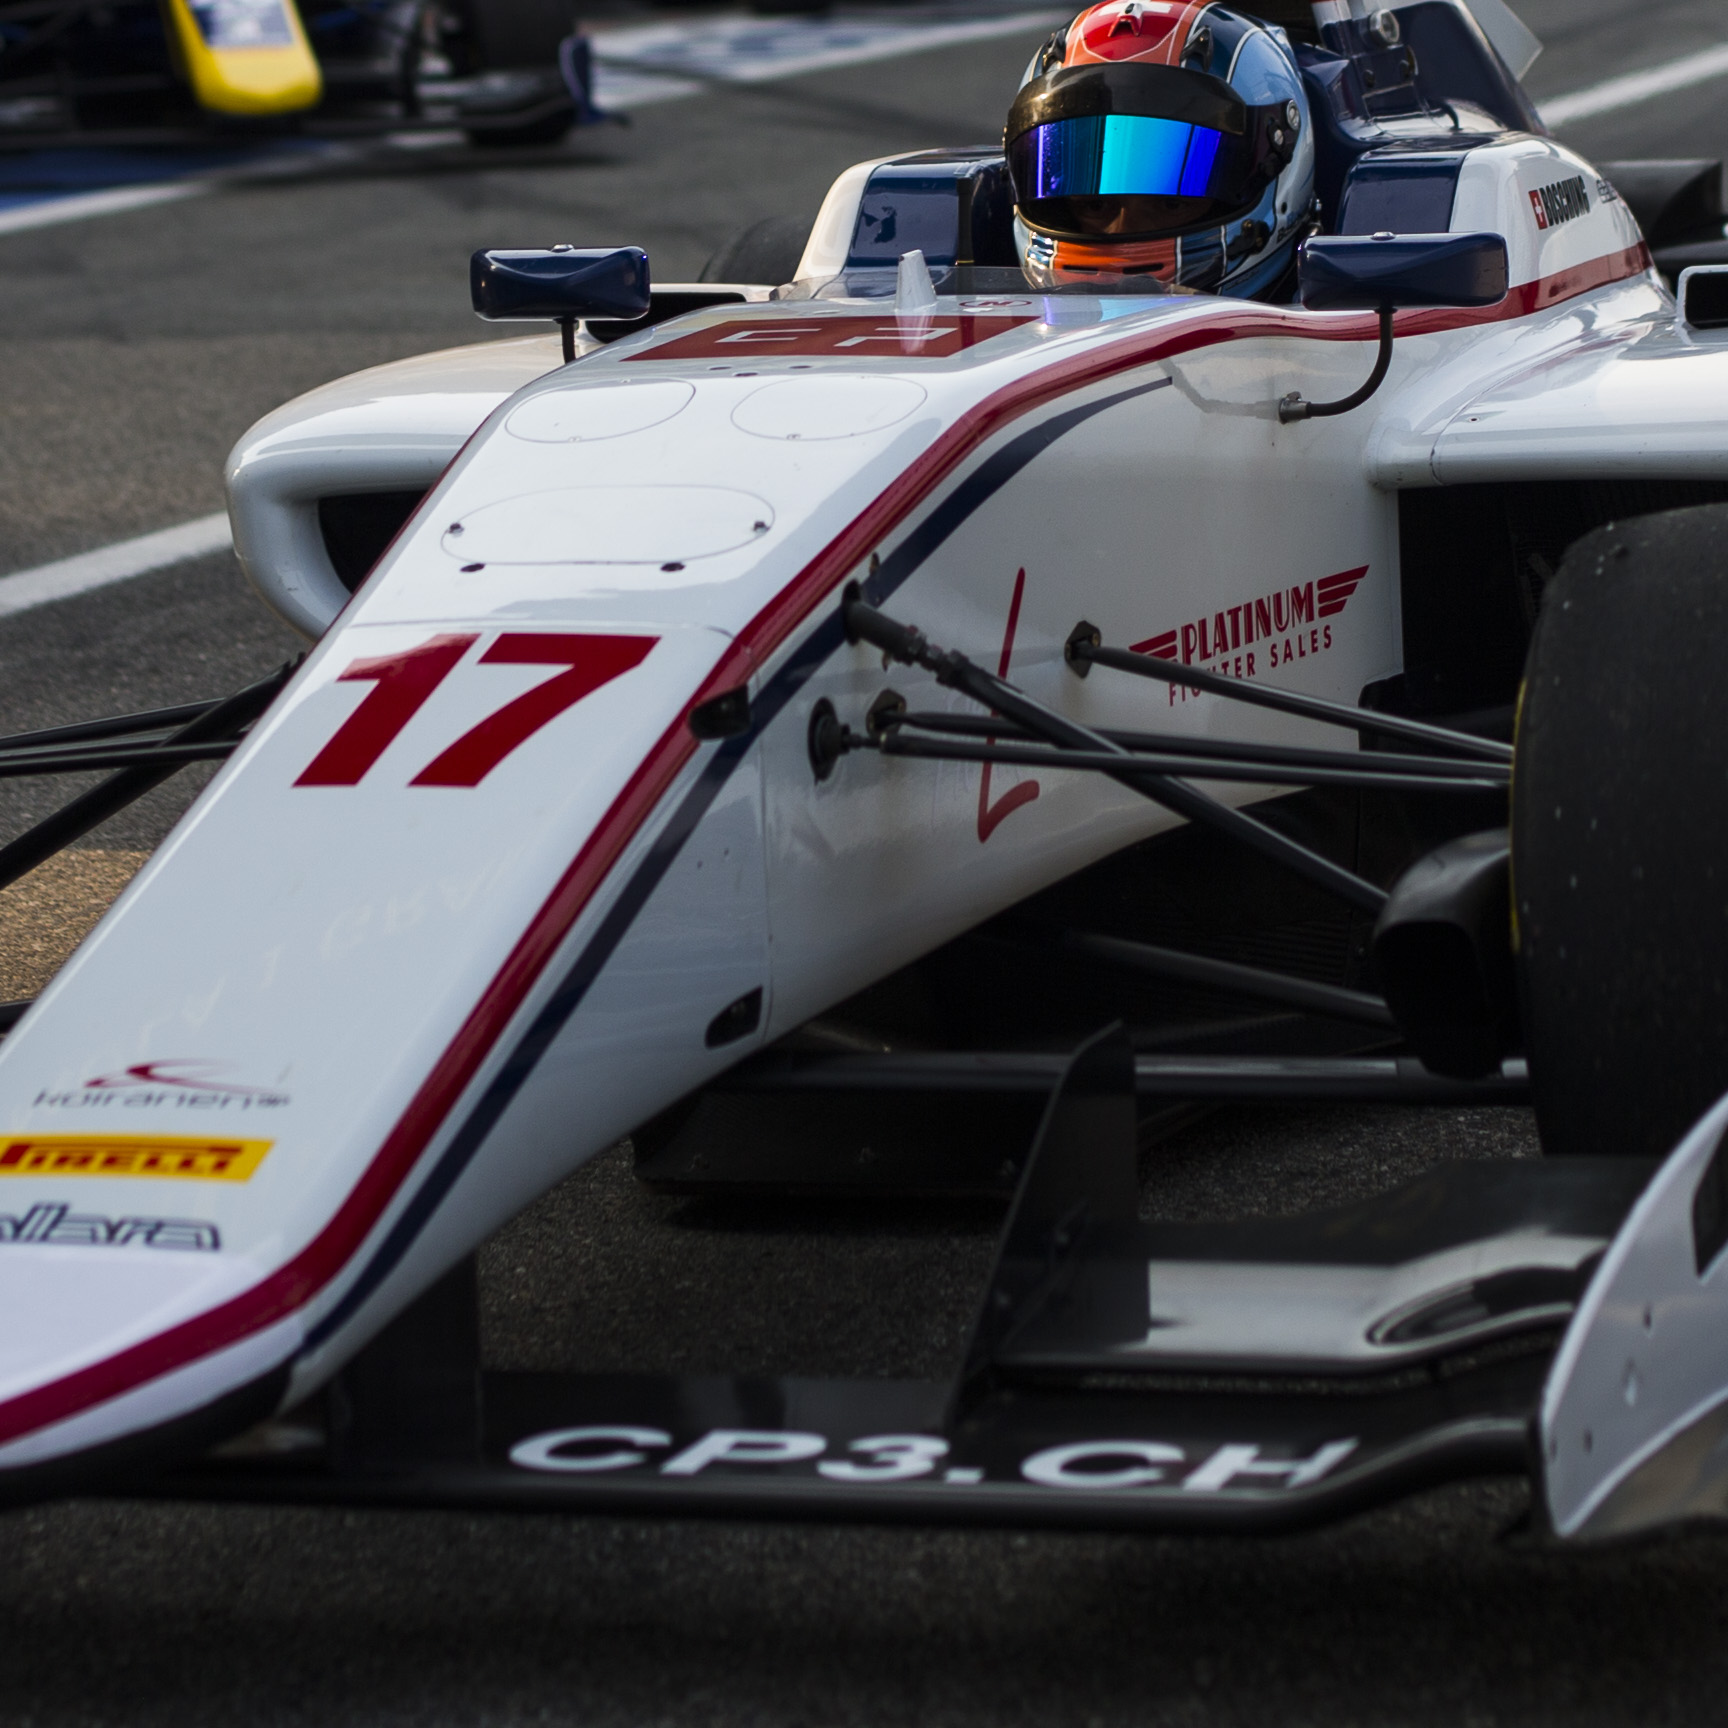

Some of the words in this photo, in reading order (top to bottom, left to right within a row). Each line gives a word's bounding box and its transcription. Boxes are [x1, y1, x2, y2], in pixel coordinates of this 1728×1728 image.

[1180, 580, 1315, 666] PLATINUM
[1269, 624, 1333, 669] SALES
[290, 631, 663, 789] 17
[508, 1425, 1360, 1492] CP3.CH
